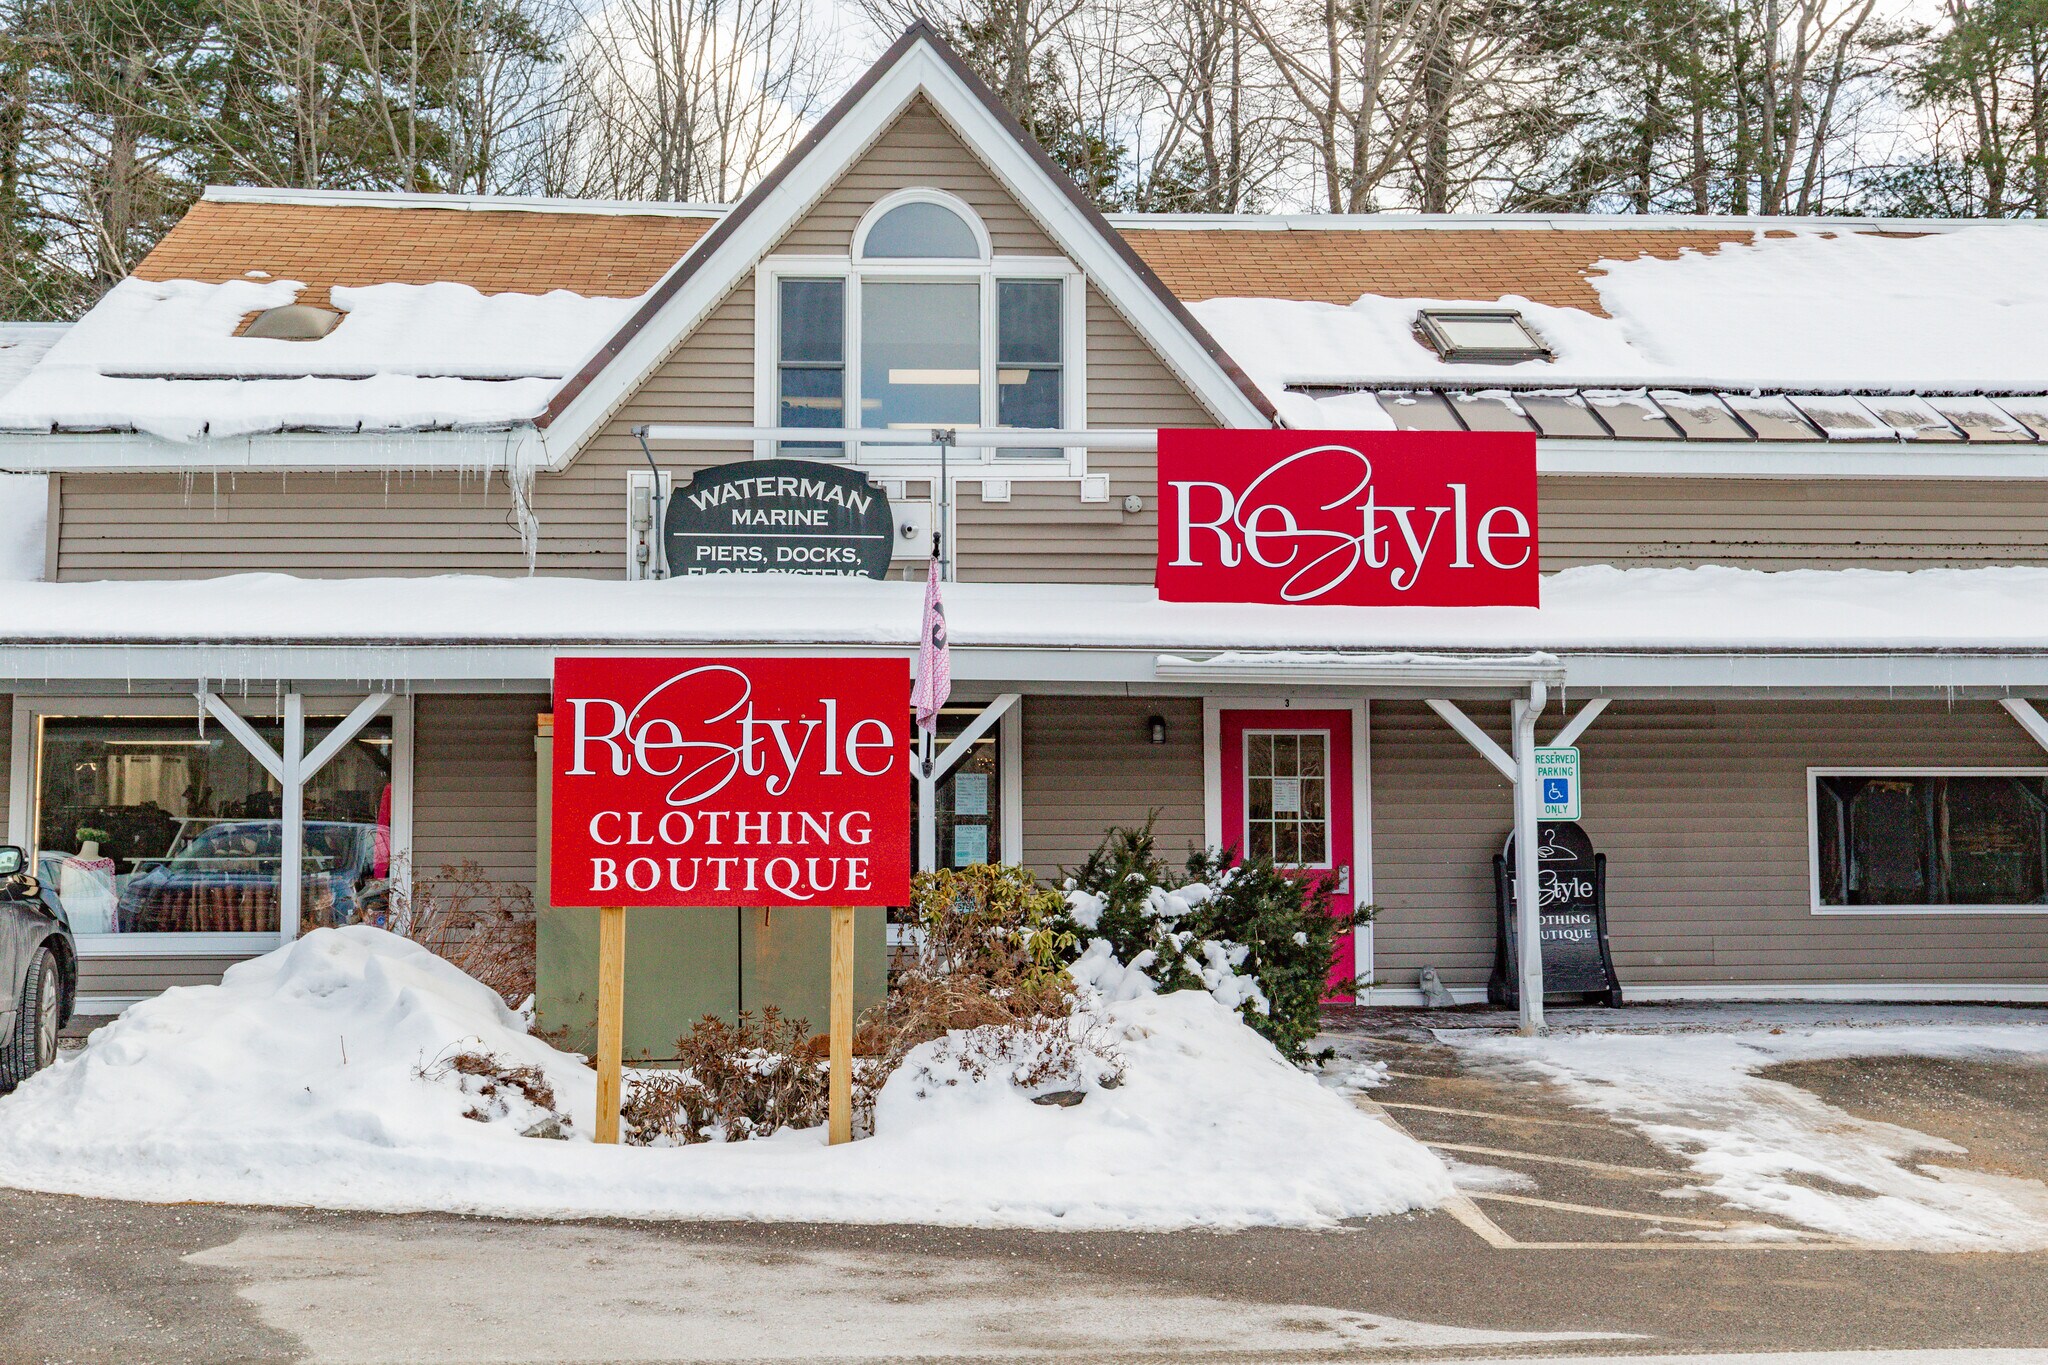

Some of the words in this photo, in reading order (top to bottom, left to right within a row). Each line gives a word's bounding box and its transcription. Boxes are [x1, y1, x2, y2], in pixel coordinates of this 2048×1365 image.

[688, 476, 872, 515] WATERMAN
[732, 510, 828, 526] MARINE
[1168, 444, 1532, 602] ReStyle
[696, 545, 768, 564] PIERS,
[777, 546, 862, 566] DOCKS,
[1285, 698, 1290, 708] 3
[564, 664, 894, 807] ReStyle
[1535, 754, 1576, 764] RESERVED
[1538, 767, 1573, 776] PARKING
[1545, 804, 1568, 814] ONLY
[589, 811, 872, 846] CLOTHING
[589, 857, 872, 901] BOUTIQUE
[1539, 914, 1591, 925] OTHING
[1540, 928, 1592, 942] UTIQUE
